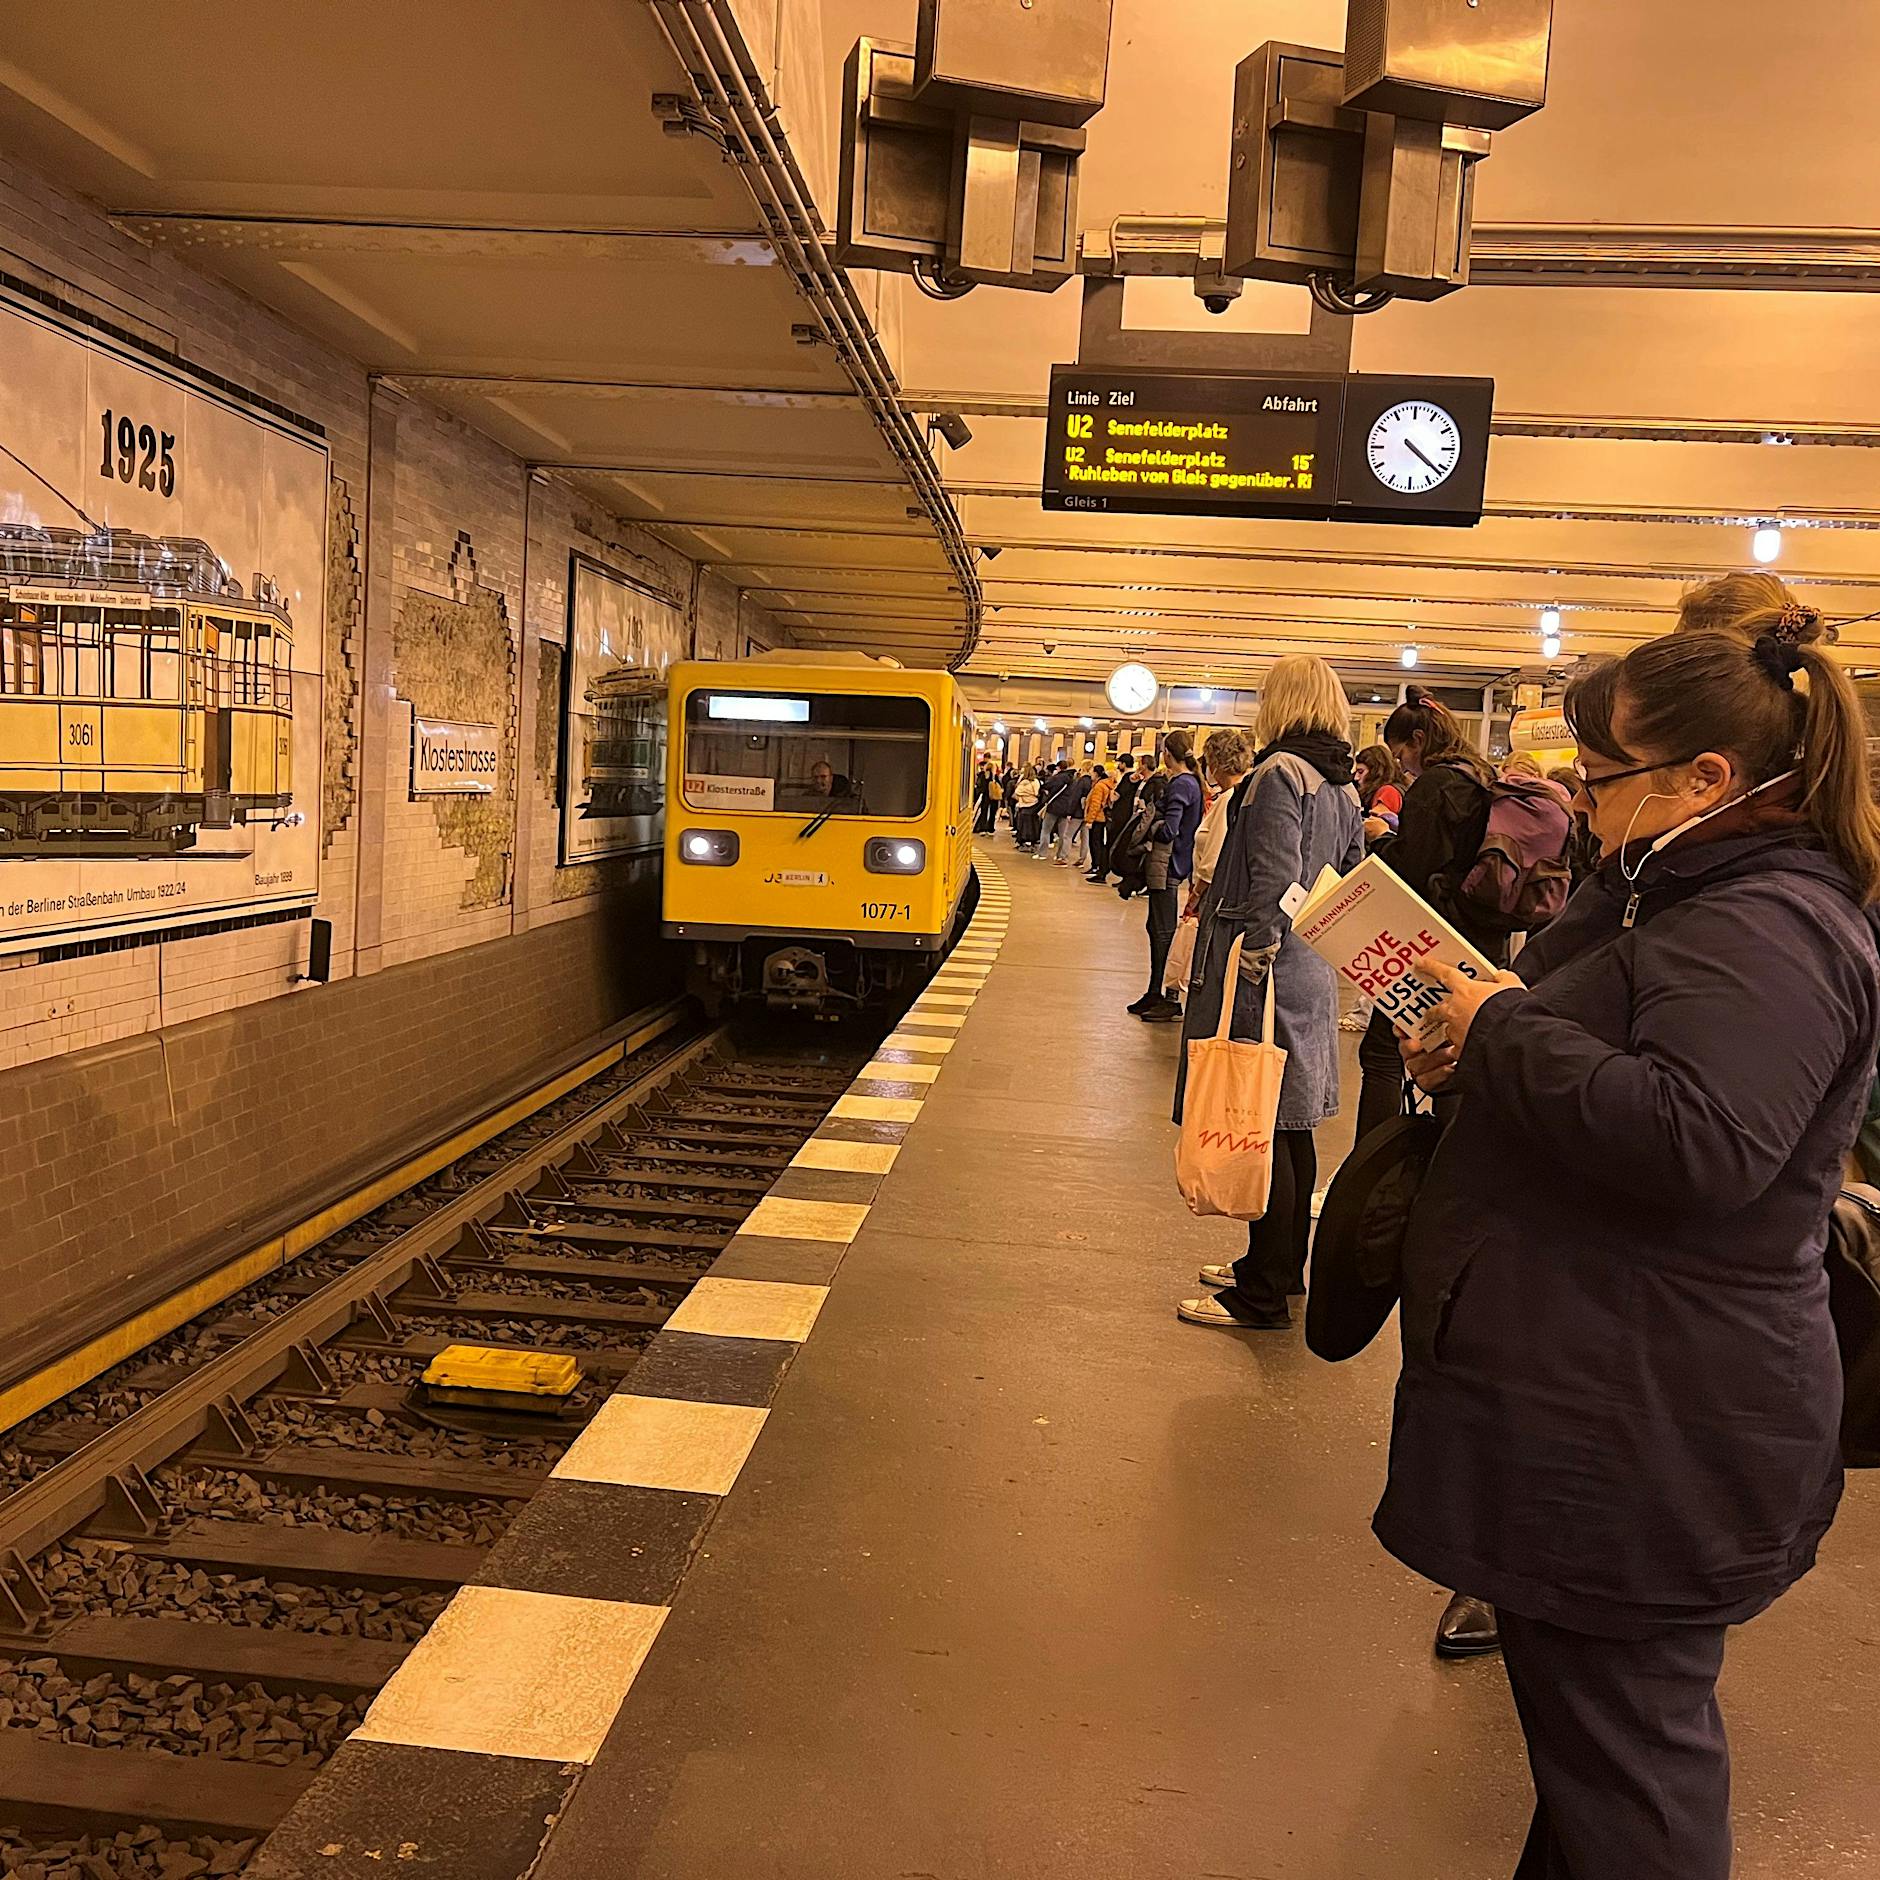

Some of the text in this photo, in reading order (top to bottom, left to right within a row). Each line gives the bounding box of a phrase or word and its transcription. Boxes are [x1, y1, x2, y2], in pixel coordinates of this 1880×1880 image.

[1067, 391, 1135, 406] Linie Ziel
[1262, 396, 1318, 413] Abfahrt
[1067, 414, 1229, 441] U2 Senefelderplatz
[100, 408, 176, 498] 1925
[1065, 447, 1086, 463] U2
[1106, 447, 1227, 469] Senefelderplatz
[1069, 464, 1138, 483] Ruhleben
[1140, 470, 1169, 484] vom
[1171, 468, 1208, 486] Gleis
[1210, 471, 1295, 490] gegenüber.
[1064, 496, 1108, 509] Gleis 1
[68, 722, 94, 748] 3061
[420, 736, 496, 773] Klosterstrasse
[686, 780, 766, 797] U2 Klosterstraße
[254, 873, 280, 888] Baujahr
[8, 901, 24, 916] der
[27, 897, 66, 914] Berliner
[68, 890, 124, 909] Straßenbahn
[126, 886, 156, 902] Umbau
[157, 881, 187, 899] 1922/24
[860, 902, 911, 921] 1077-1
[1302, 924, 1321, 940] THE
[1320, 880, 1371, 927] MINIMALISTS
[1340, 930, 1402, 982] LOVE
[1359, 929, 1441, 998] PEOPLE
[1376, 973, 1425, 1011] USE
[1393, 960, 1478, 1026] THINS
